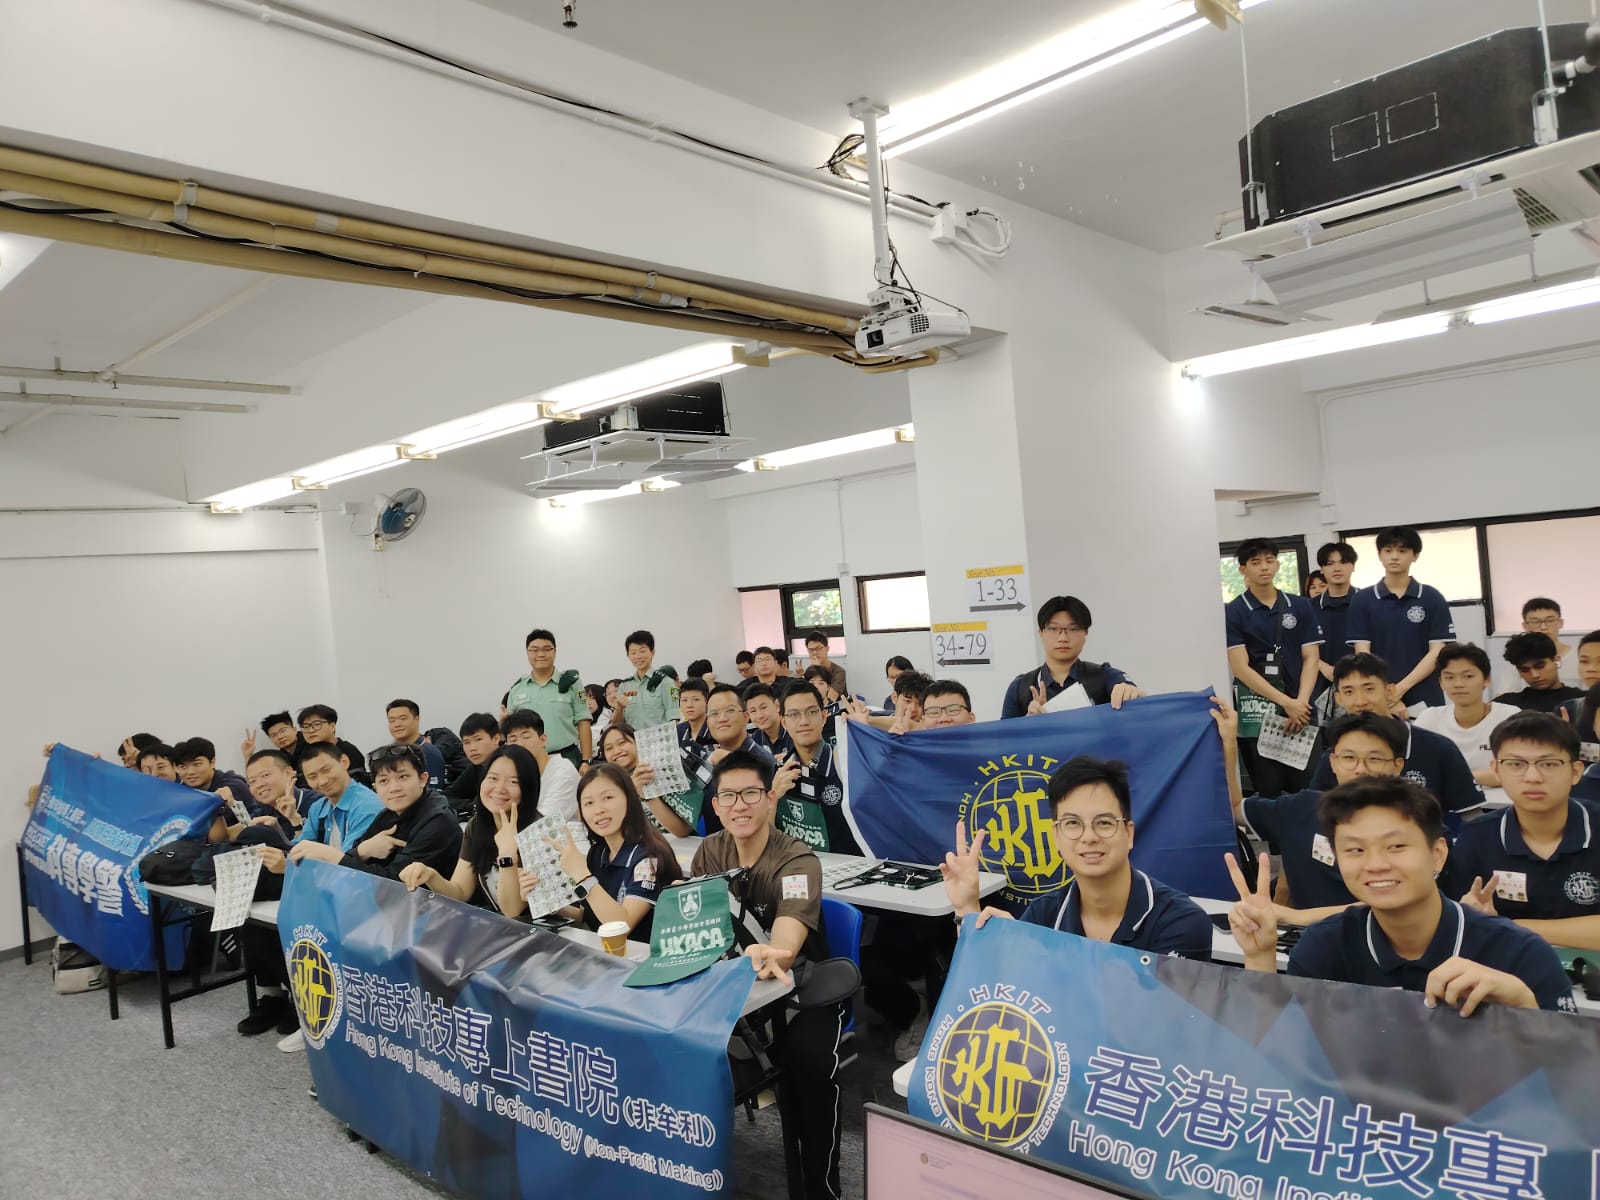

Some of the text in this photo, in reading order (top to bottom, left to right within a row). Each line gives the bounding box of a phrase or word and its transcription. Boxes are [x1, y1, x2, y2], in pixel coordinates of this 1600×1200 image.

[976, 577, 1017, 602] 1-33
[935, 633, 987, 656] 34-79
[978, 753, 1058, 776] HKIT
[293, 924, 328, 946] HKIT
[660, 927, 726, 958] HKACA
[968, 983, 1052, 1016] HKIT
[341, 963, 620, 1125] 香港科技專上書院
[925, 1015, 954, 1117] HONG KONG
[345, 1019, 378, 1058] Hong
[379, 1034, 414, 1074] Kong
[414, 1048, 462, 1097] Institute
[462, 1081, 480, 1107] of
[481, 1084, 584, 1155] Technology
[583, 1134, 658, 1175] (Non-Profit
[658, 1157, 724, 1192] Making)
[1028, 1041, 1070, 1147] TECHNOLOGY
[1069, 1120, 1157, 1180] Hong
[1165, 1150, 1263, 1200] Kong
